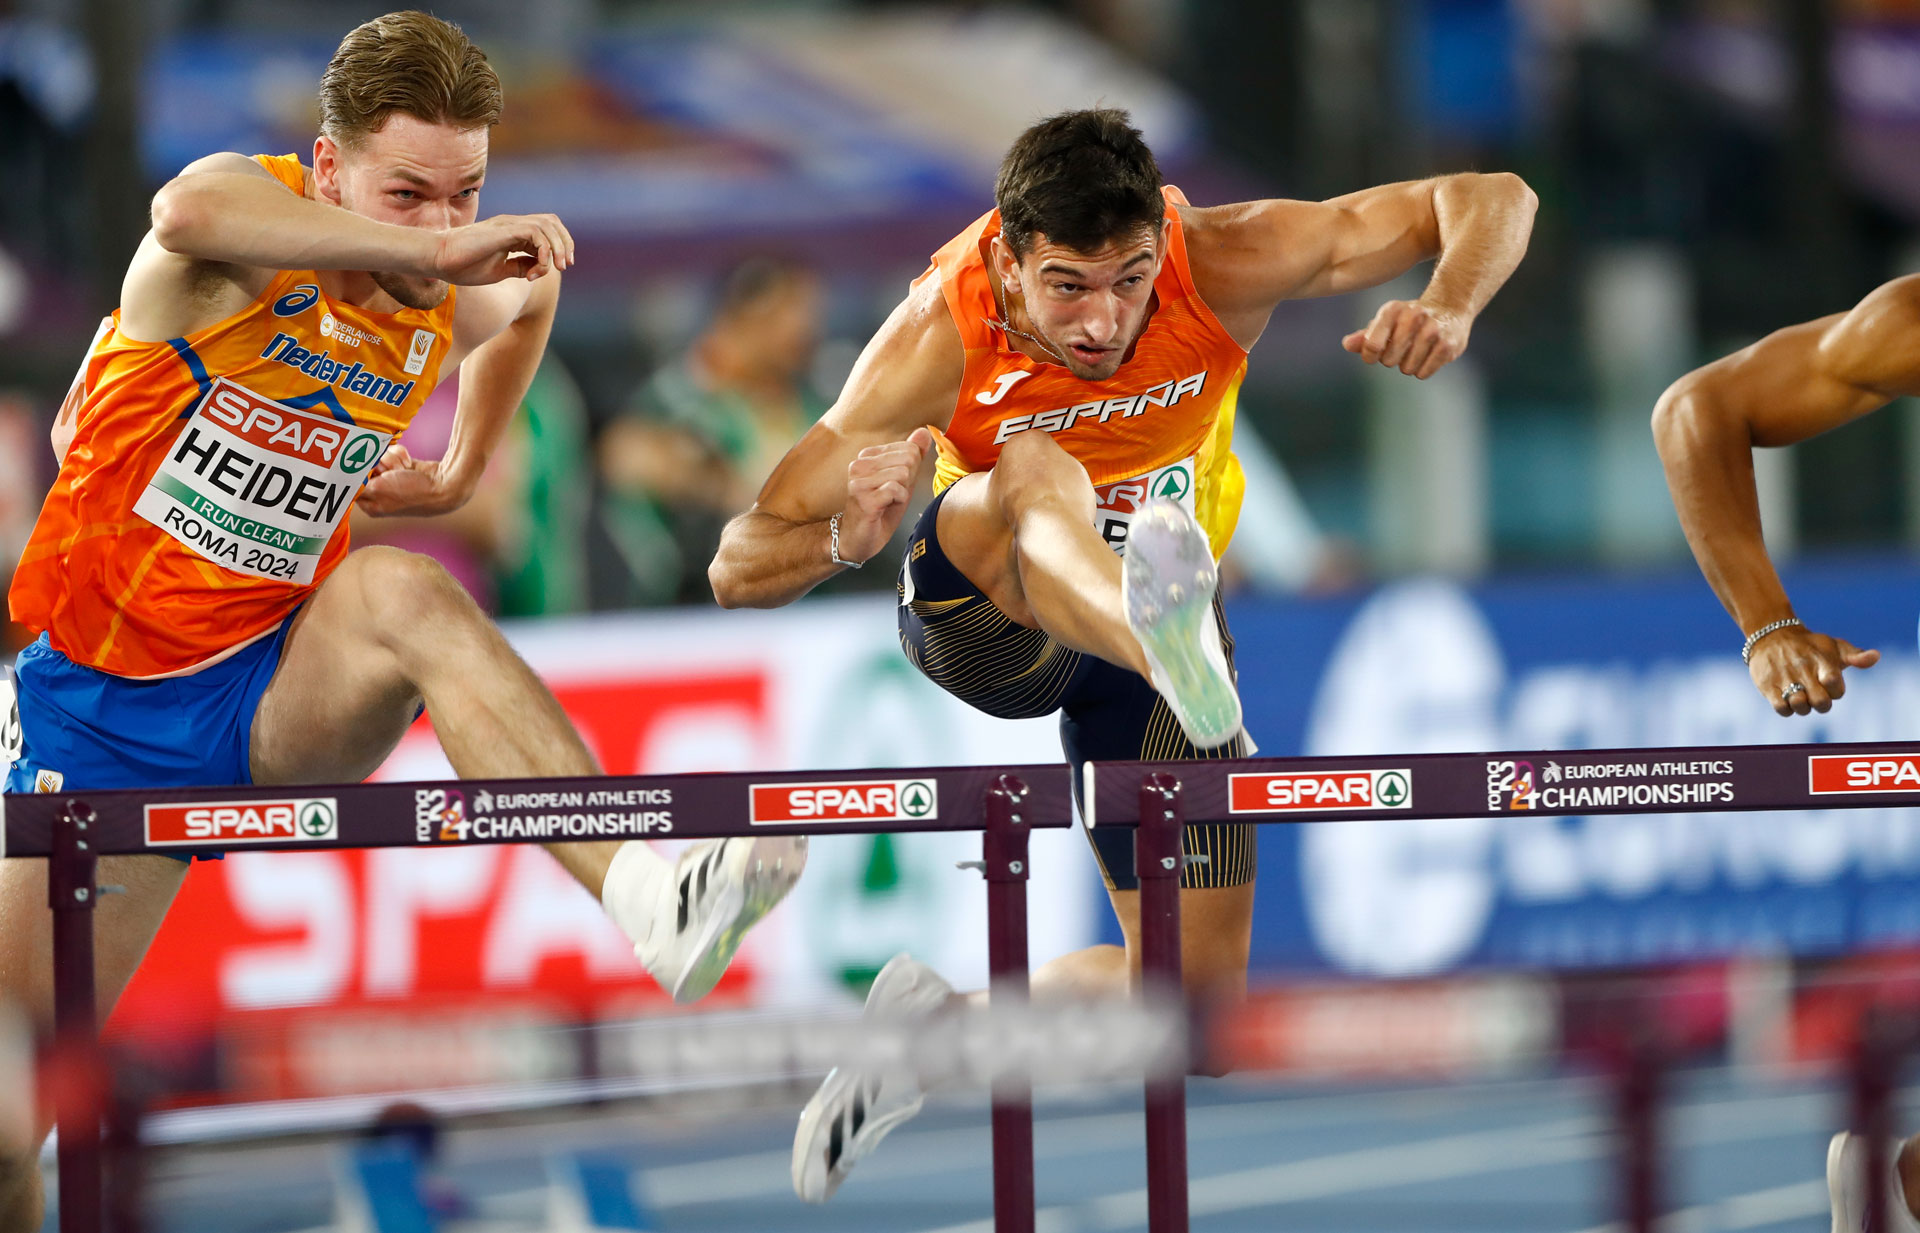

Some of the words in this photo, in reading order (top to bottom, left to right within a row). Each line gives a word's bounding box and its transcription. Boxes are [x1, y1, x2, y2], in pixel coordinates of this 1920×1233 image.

[992, 370, 1208, 446] ESPAÑA
[208, 390, 341, 462] SPAR
[173, 427, 351, 524] HEIDEN
[191, 495, 201, 508] I
[199, 500, 242, 532] RUN
[163, 506, 239, 563] ROMA
[242, 548, 299, 580] 2024
[1564, 763, 1648, 780] EUROPEAN
[1651, 760, 1734, 777] ATHLETICS
[1846, 760, 1920, 786] SPA
[496, 792, 583, 810] EUROPEAN
[586, 789, 673, 807] ATHLETICS
[1267, 777, 1371, 805] SPAR
[1486, 761, 1502, 811] roma
[1542, 782, 1735, 808] CHAMPIONSHIPS
[789, 787, 895, 817] SPAR
[184, 806, 294, 838] SPAR
[473, 811, 674, 840] CHAMPIONSHIPS
